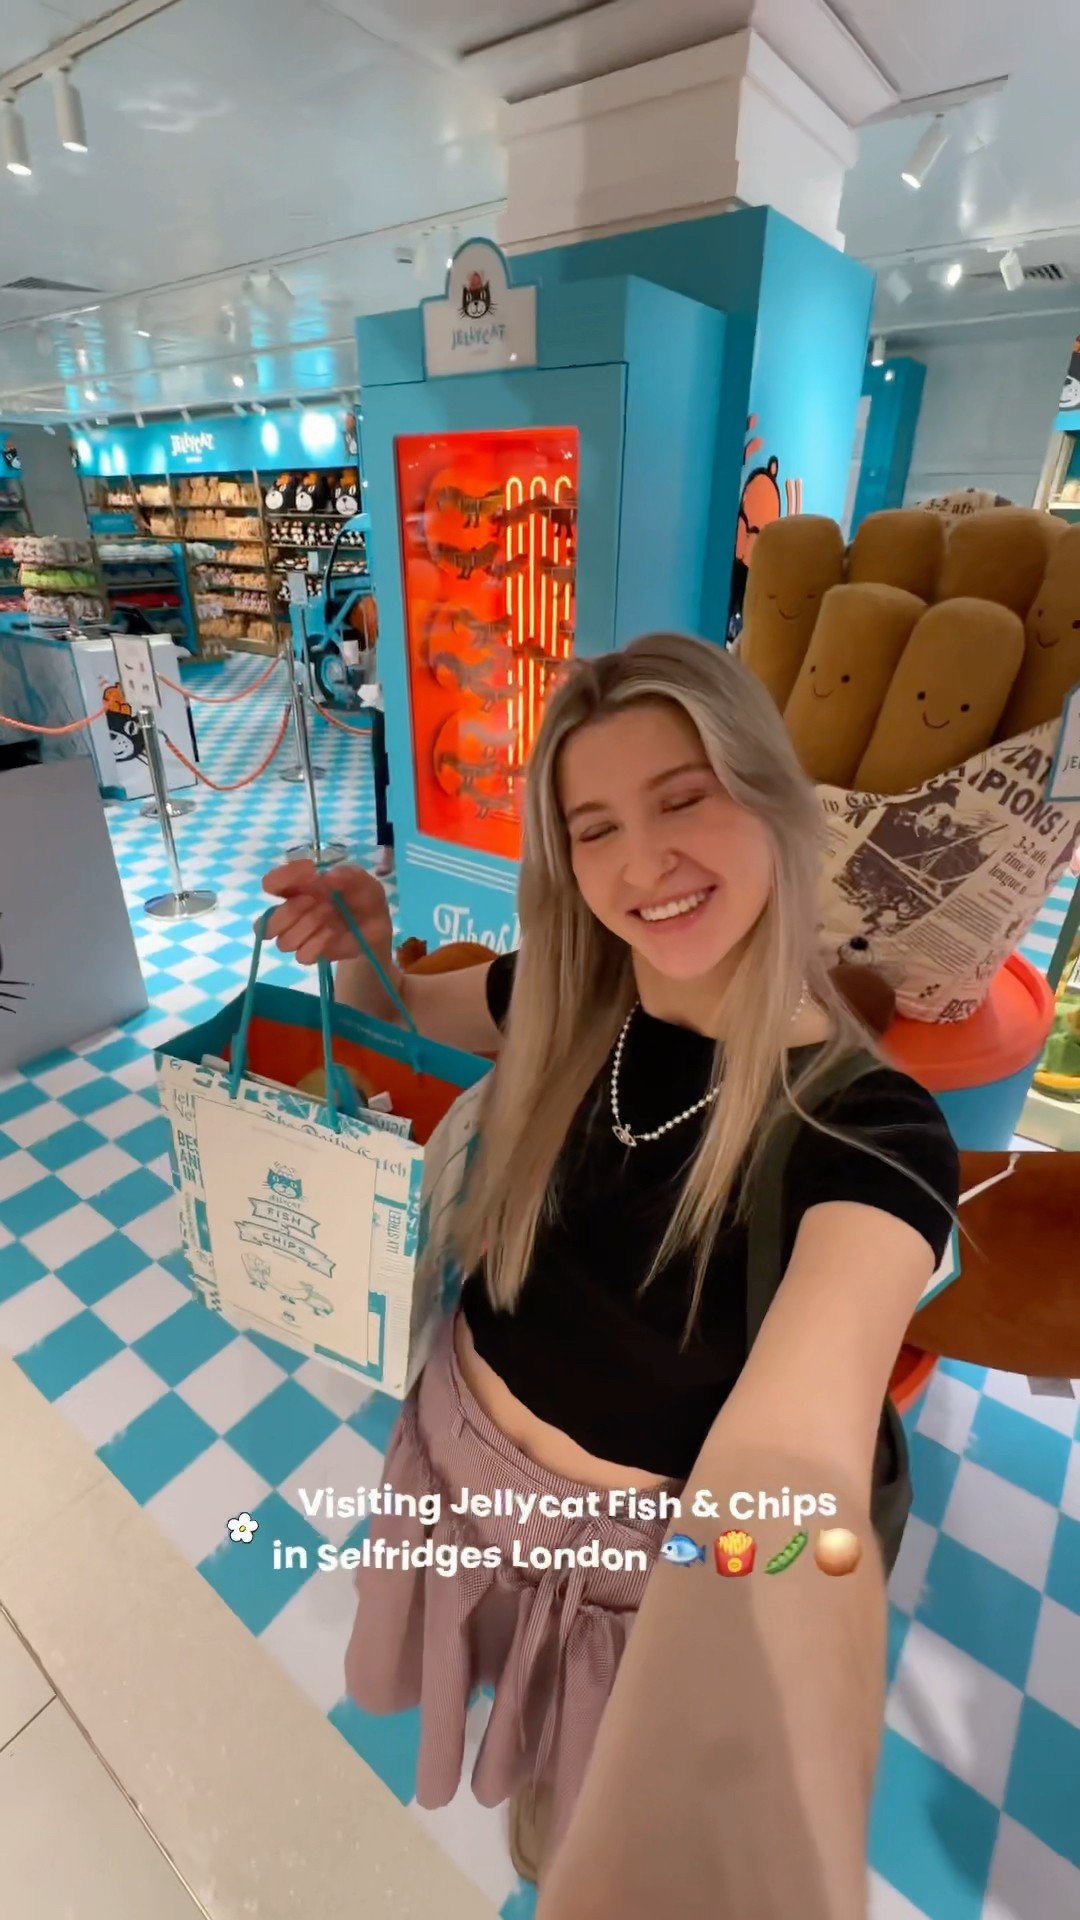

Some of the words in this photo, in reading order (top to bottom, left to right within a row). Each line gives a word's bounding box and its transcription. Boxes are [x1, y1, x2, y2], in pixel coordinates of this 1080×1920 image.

[451, 323, 505, 350] JELLYCAT
[1062, 755, 1080, 773] JE
[267, 1207, 301, 1227] FISH
[387, 1208, 401, 1240] STREET
[262, 1231, 306, 1256] CHIPS
